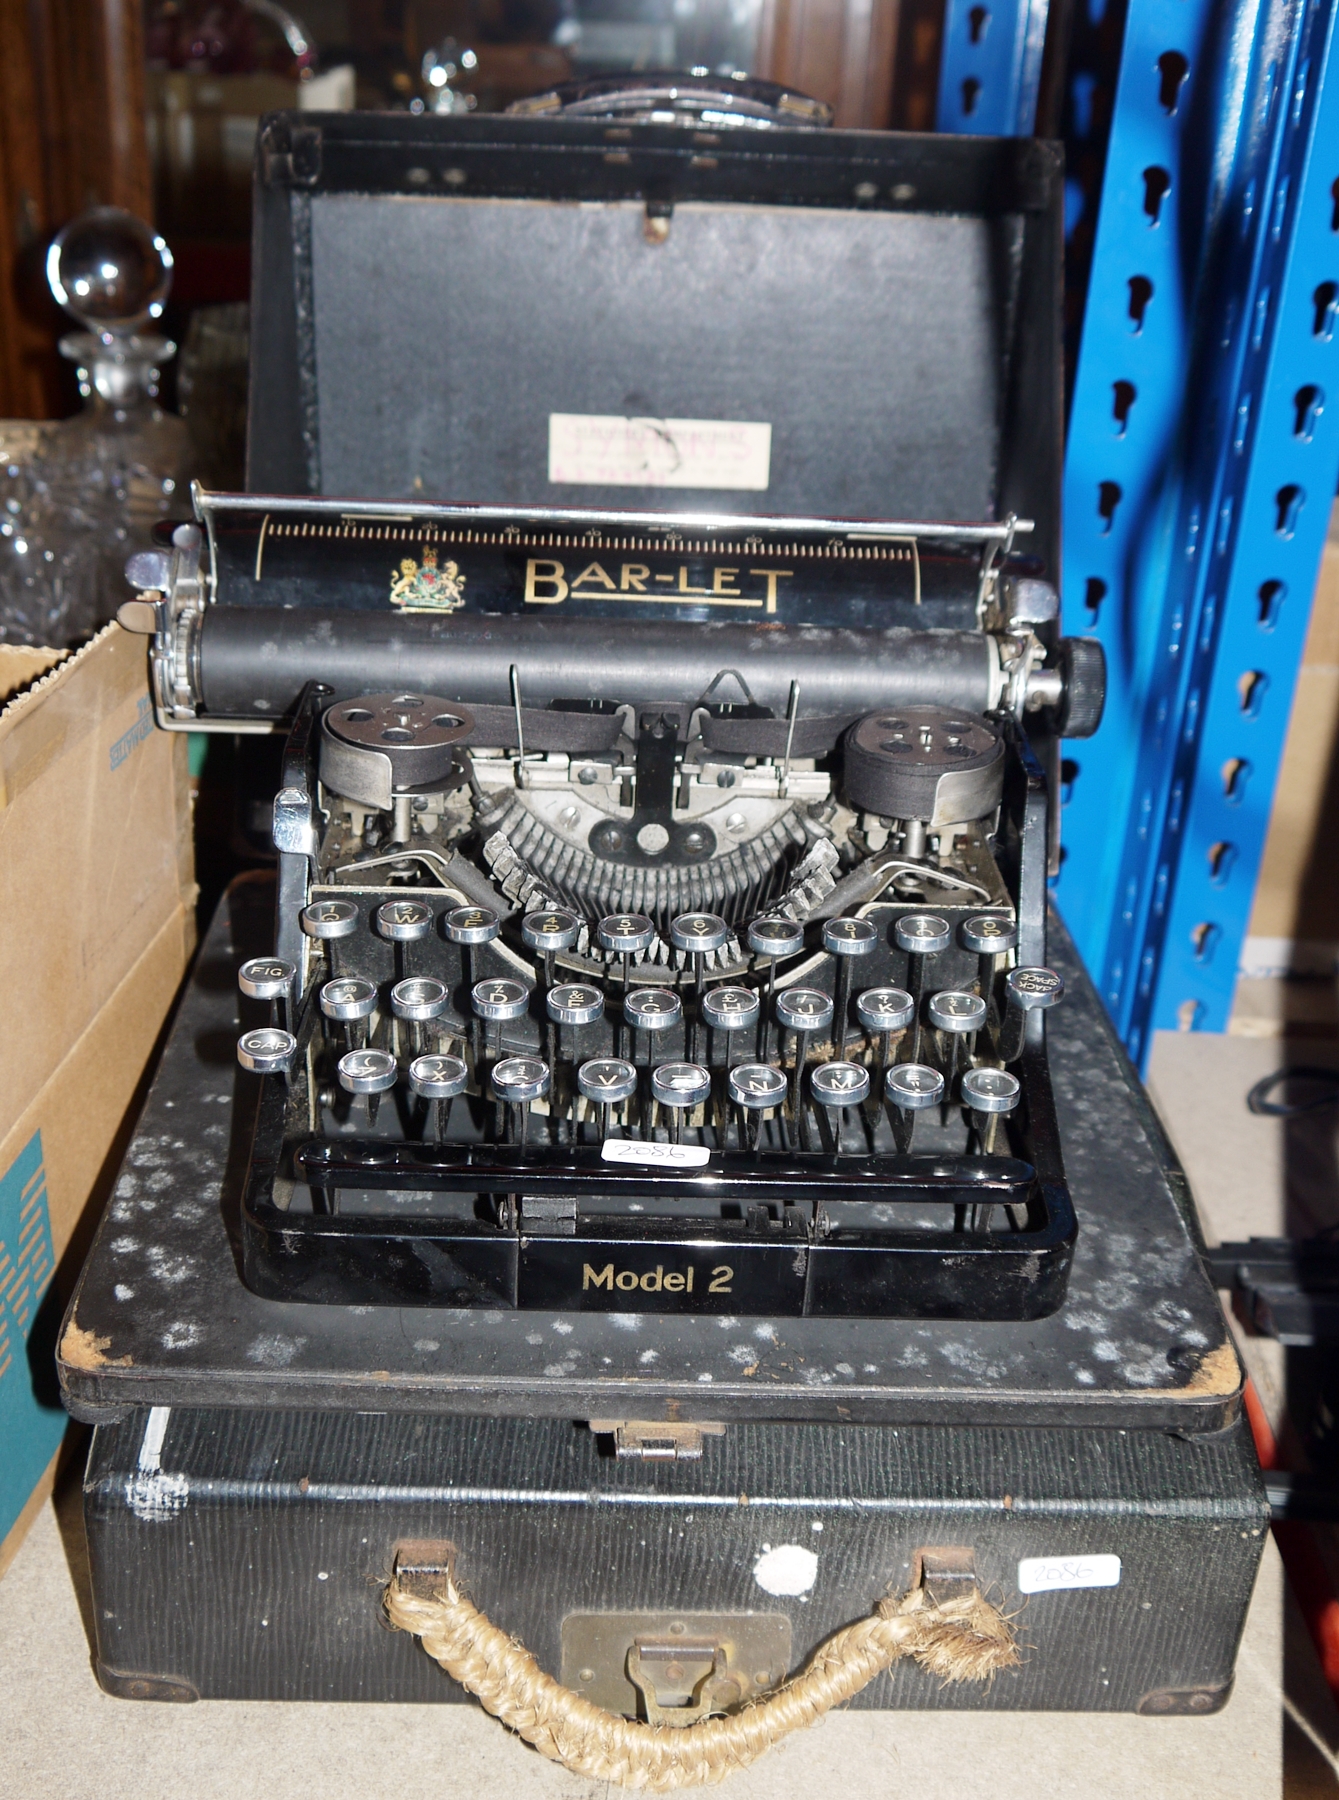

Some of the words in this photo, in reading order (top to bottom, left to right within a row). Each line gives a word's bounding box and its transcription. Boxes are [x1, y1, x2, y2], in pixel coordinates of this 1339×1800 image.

[524, 558, 794, 614] BAR-LET
[402, 906, 413, 914] 2
[395, 914, 420, 924] W
[469, 911, 482, 920] 3
[545, 916, 558, 924] 4
[620, 919, 632, 927] 5
[693, 919, 706, 928] 6
[844, 923, 856, 931] 8
[616, 927, 635, 936] T
[692, 927, 709, 936] Y
[250, 966, 285, 977] FIG.
[1020, 973, 1059, 987] SPACE
[342, 993, 356, 1003] A
[489, 993, 509, 1003] D
[569, 990, 584, 1000] &
[640, 1003, 661, 1013] G
[878, 1003, 895, 1013] K
[948, 1005, 967, 1016] L
[431, 1070, 447, 1081] X
[598, 1074, 618, 1086] V
[748, 1080, 769, 1091] N
[830, 1078, 852, 1089] M
[615, 1144, 686, 1159] 2086
[582, 1263, 694, 1293] Model
[708, 1265, 734, 1293] 2
[1034, 1562, 1094, 1582] 2086
